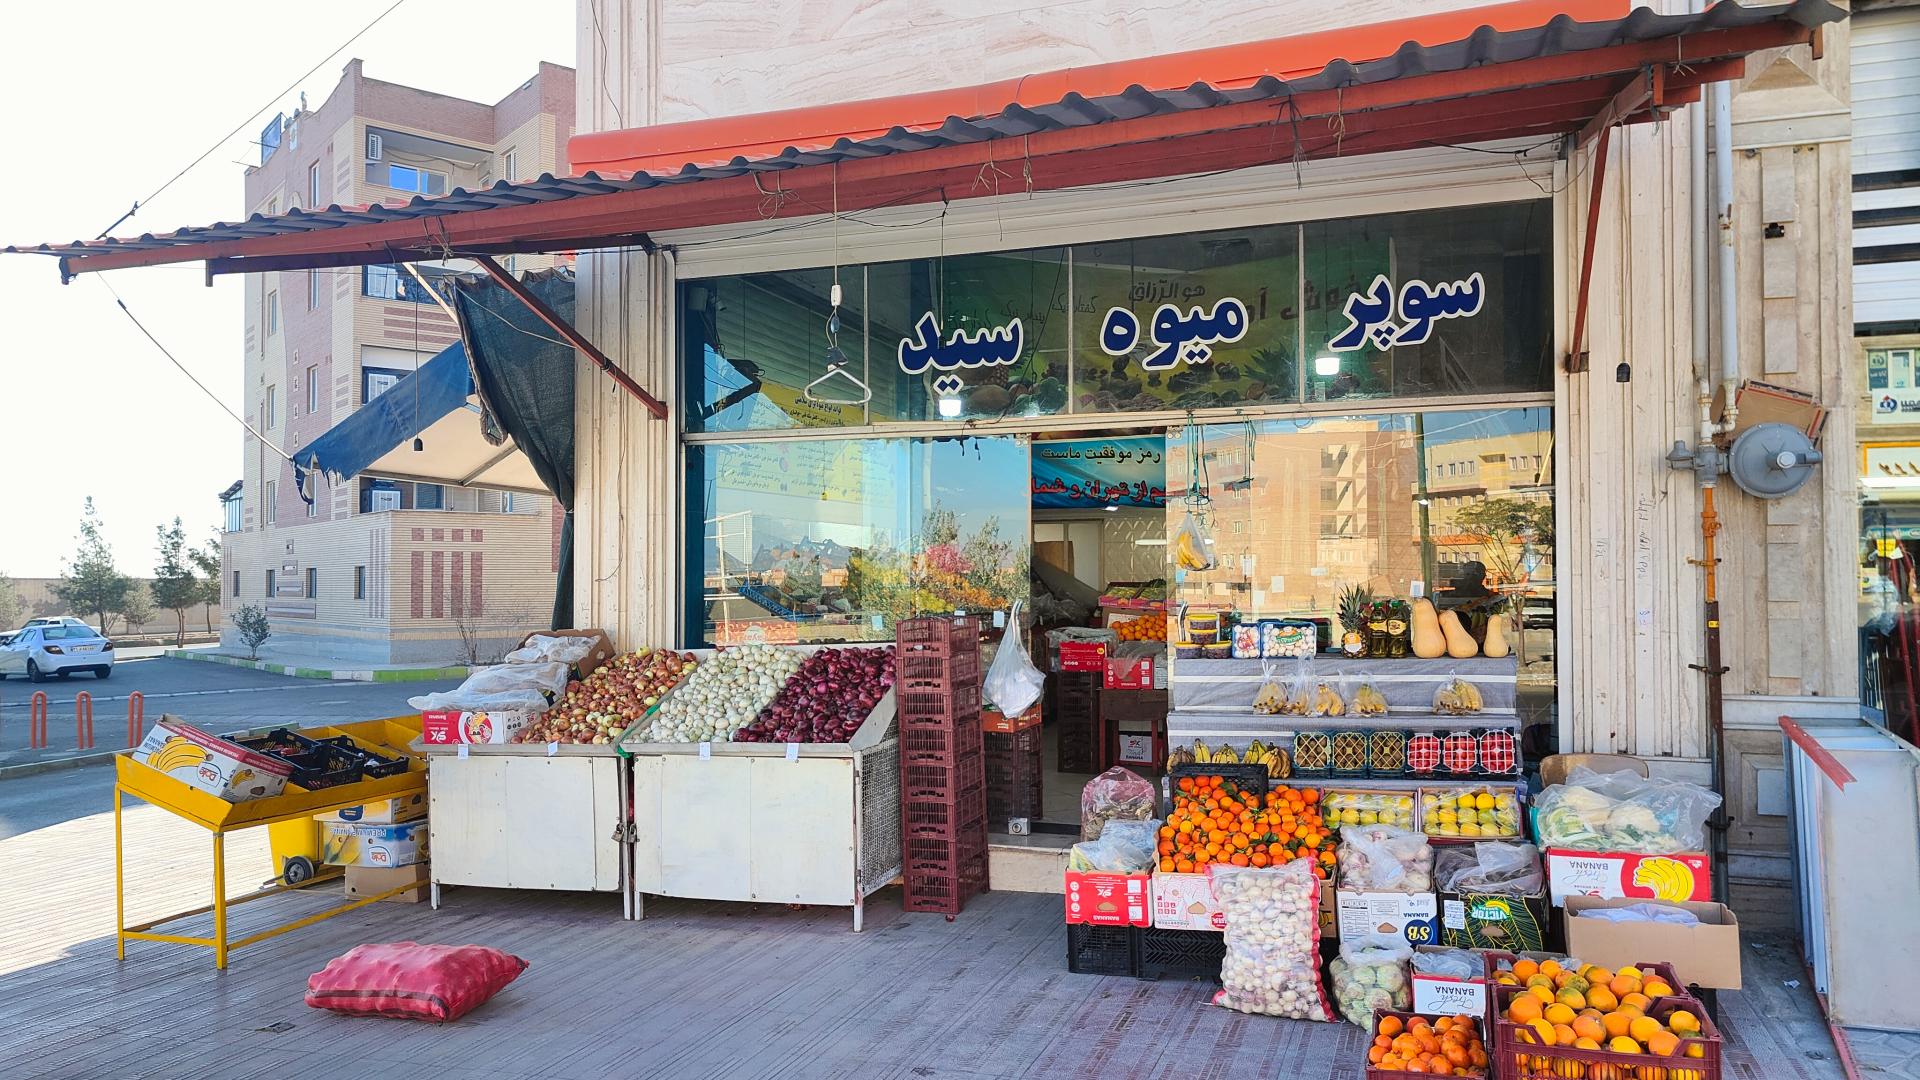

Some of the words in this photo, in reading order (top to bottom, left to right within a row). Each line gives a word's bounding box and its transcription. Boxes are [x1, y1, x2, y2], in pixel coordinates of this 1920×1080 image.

[1327, 270, 1485, 352] سوپر
[1100, 292, 1248, 371] میوه
[897, 310, 1024, 397] سید
[1041, 446, 1081, 459] ماست
[1085, 446, 1132, 465] موفقیت
[1135, 447, 1161, 464] رمز
[1129, 479, 1148, 502] از
[199, 767, 217, 781] Dole
[371, 852, 387, 862] Dole
[1569, 860, 1609, 870] BANANA
[1471, 904, 1508, 920] VICTOR
[1407, 926, 1431, 941] SB
[1434, 985, 1475, 996] BANANA
